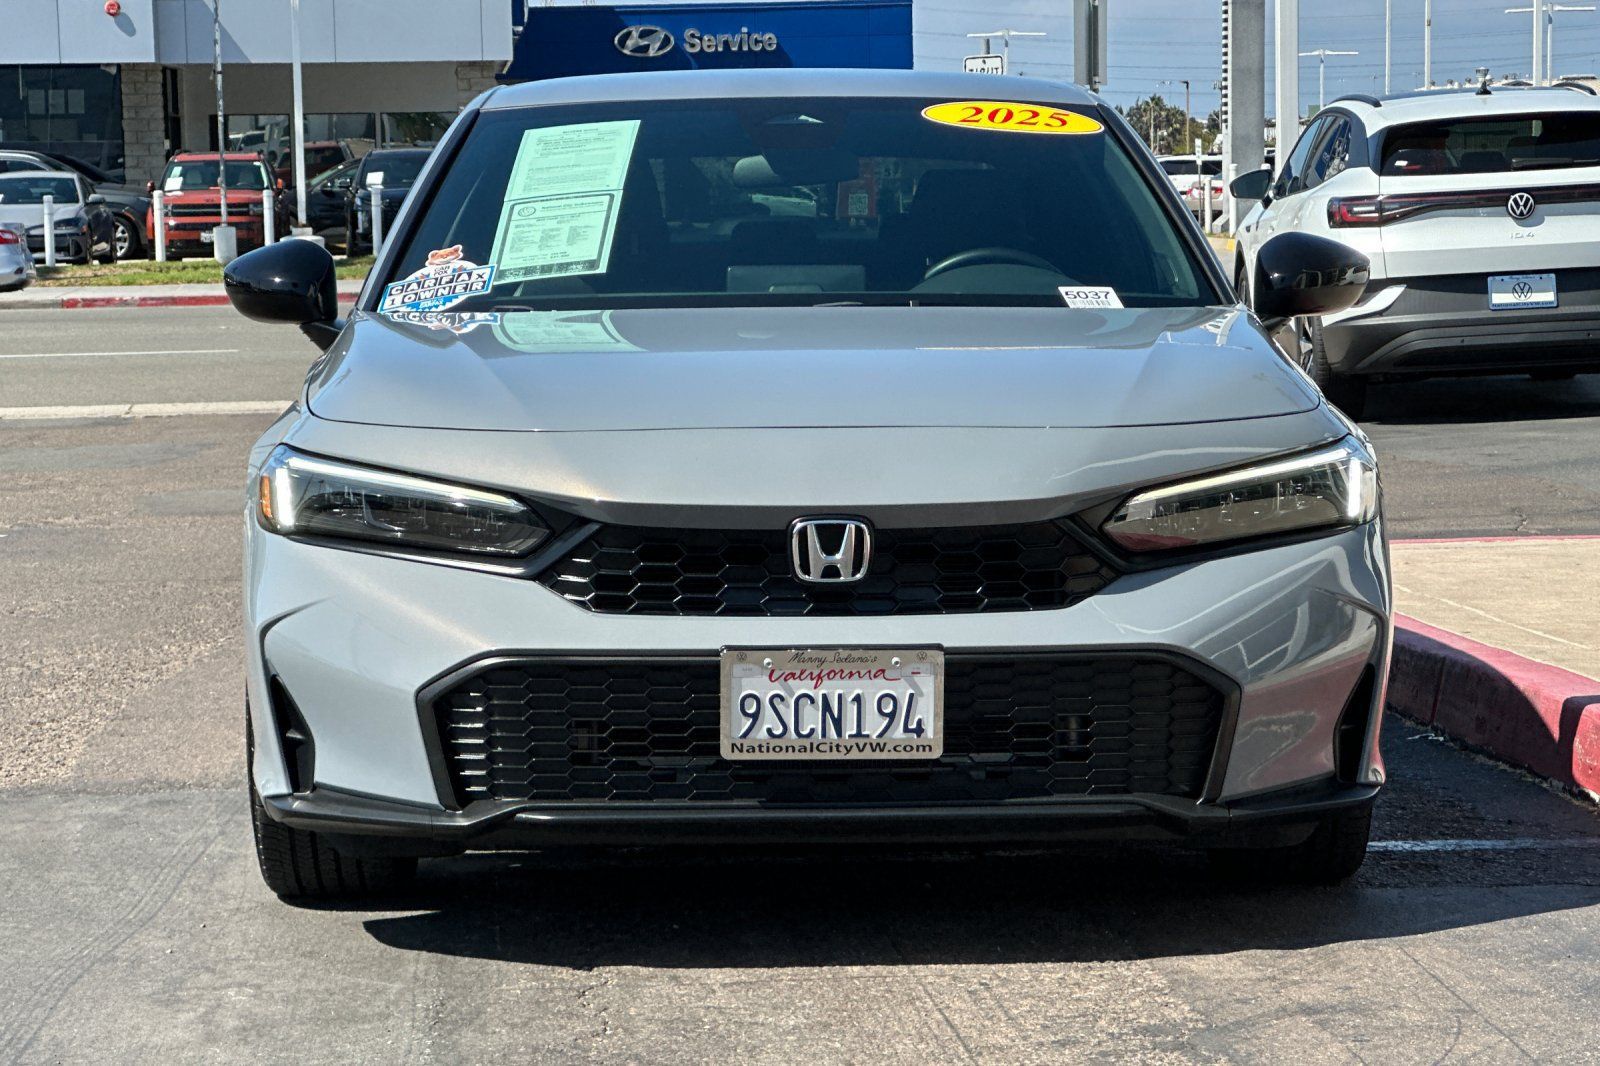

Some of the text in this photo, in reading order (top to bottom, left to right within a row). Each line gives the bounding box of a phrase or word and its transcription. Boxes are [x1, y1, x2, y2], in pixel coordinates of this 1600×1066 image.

[683, 26, 777, 53] Service
[957, 106, 1071, 128] 2025
[390, 272, 486, 295] CARFAX
[402, 282, 484, 303] OWNER
[1064, 290, 1110, 300] 5037
[787, 651, 828, 668] Manny
[768, 667, 902, 690] California
[737, 691, 926, 739] 9SCN194
[730, 741, 933, 755] NationalCityVW.com
